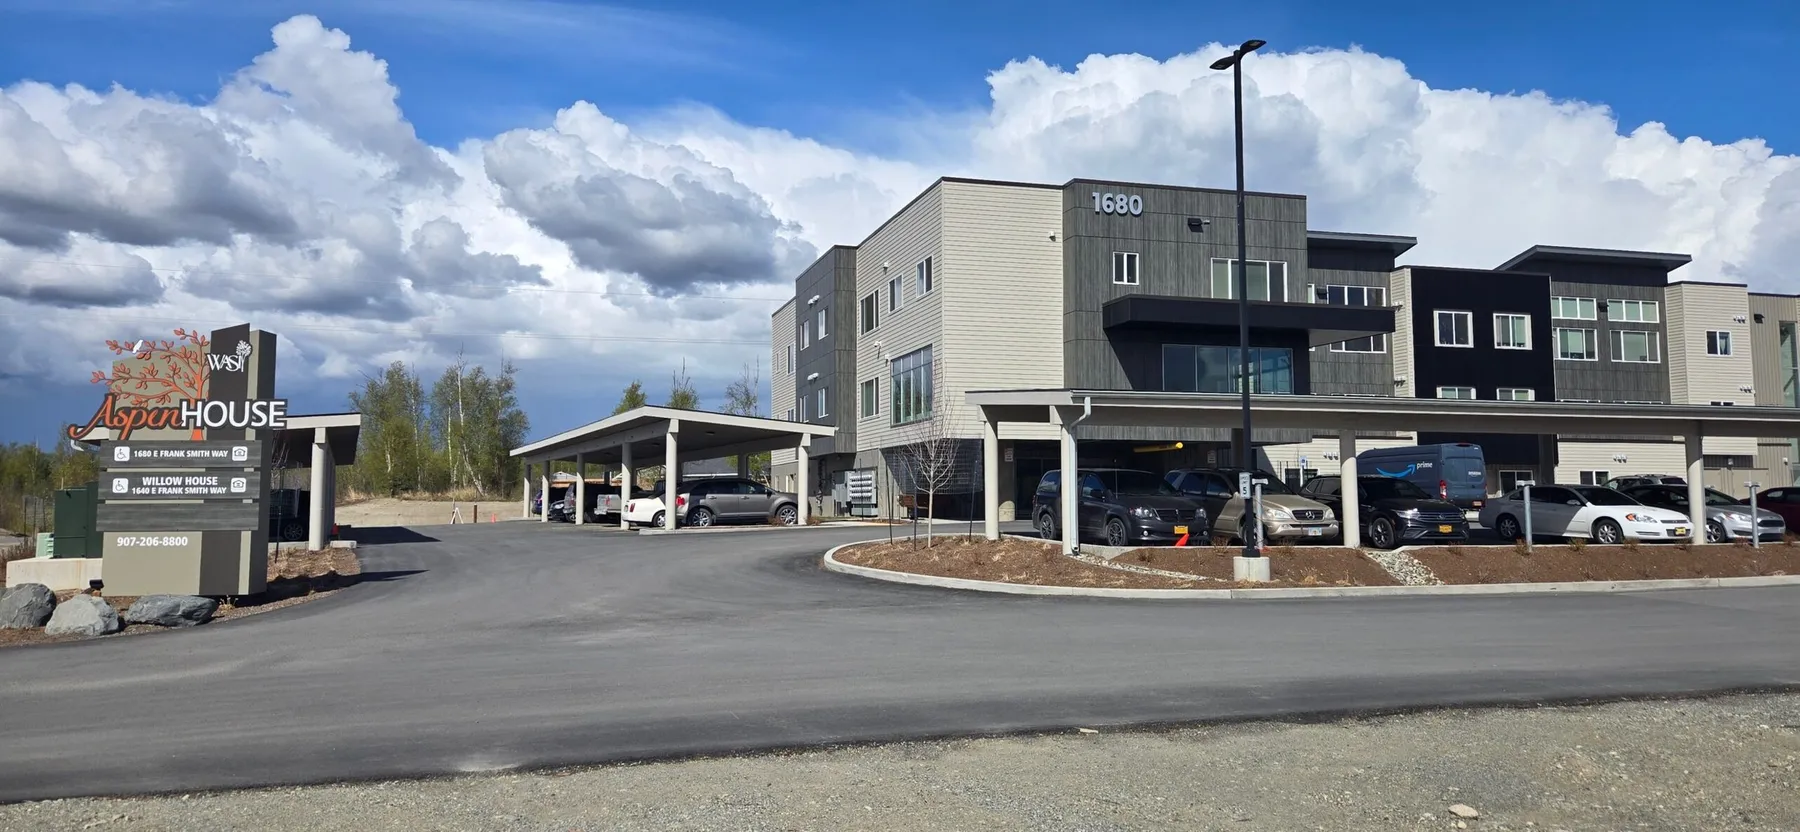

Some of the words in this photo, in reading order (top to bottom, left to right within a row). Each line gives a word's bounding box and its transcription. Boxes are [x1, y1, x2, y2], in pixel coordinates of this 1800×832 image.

[1092, 192, 1143, 215] 1680
[134, 450, 152, 458] 1680
[153, 450, 158, 458] E
[160, 450, 185, 458] FRANK
[186, 450, 210, 458] SMITH
[211, 450, 228, 458] WAY
[1416, 461, 1433, 470] prime
[142, 476, 183, 486] WILLOW
[185, 476, 218, 486] HOUSE
[132, 487, 150, 495] 1640
[151, 487, 156, 495] E
[158, 487, 183, 495] FRANK
[184, 487, 208, 495] SMITH
[209, 487, 227, 495] WAY
[1242, 486, 1248, 495] 5
[116, 537, 188, 547] 907-206-8800
